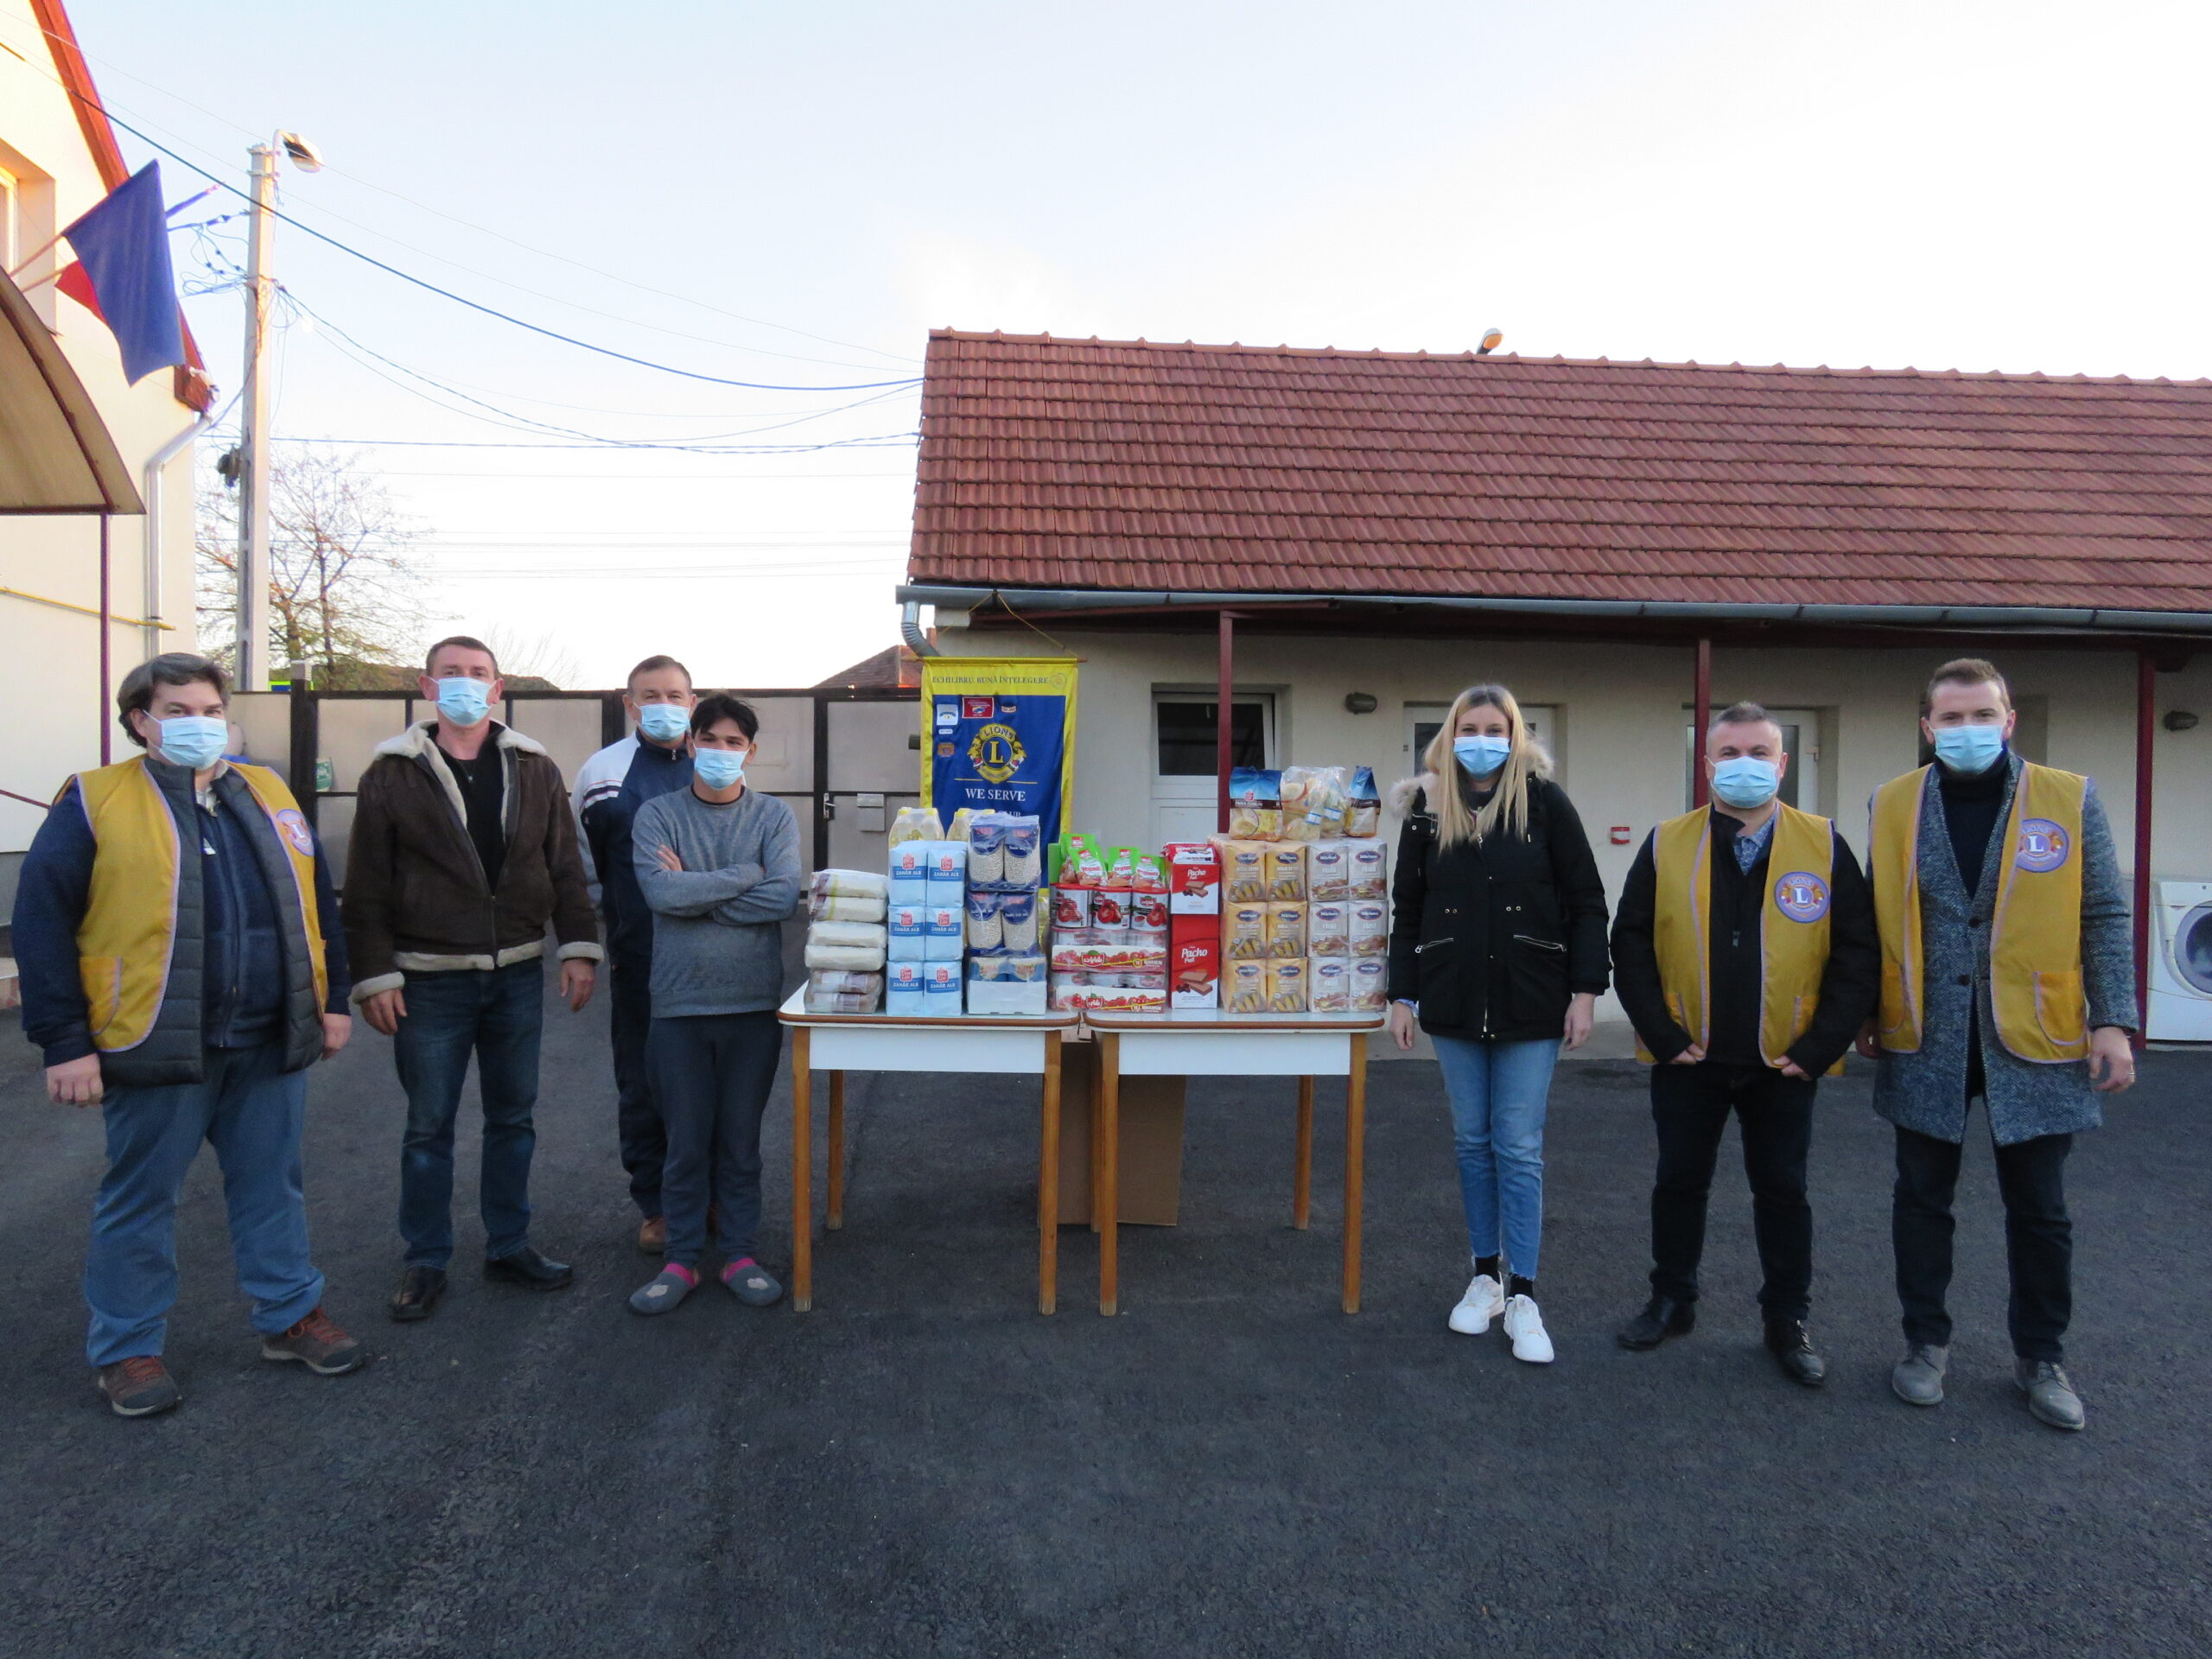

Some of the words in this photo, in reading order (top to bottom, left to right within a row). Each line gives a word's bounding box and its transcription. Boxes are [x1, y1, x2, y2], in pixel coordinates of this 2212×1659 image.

[983, 726, 1013, 739] LIONS
[988, 741, 1004, 764] L
[965, 788, 985, 799] WE
[988, 789, 1027, 802] SERVE
[2027, 836, 2044, 852] L
[1794, 887, 1808, 904] L
[1181, 947, 1208, 959] Pacho
